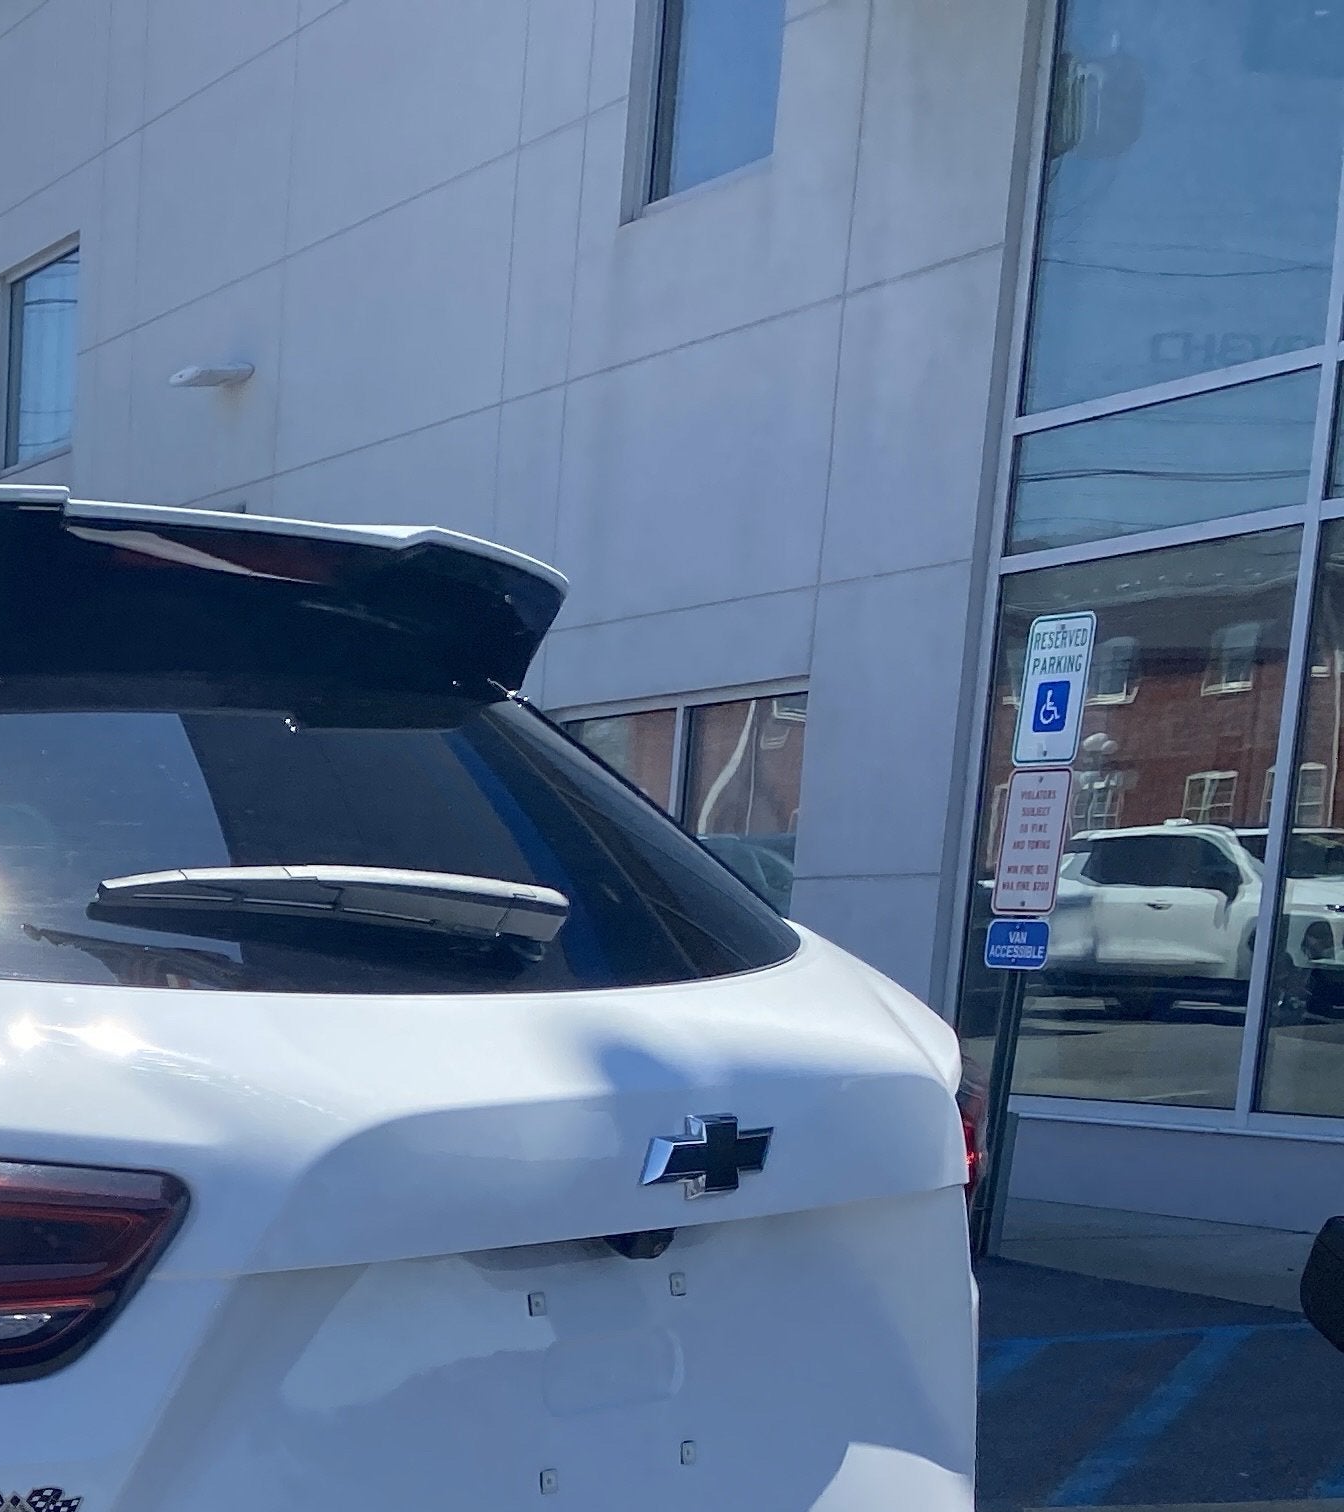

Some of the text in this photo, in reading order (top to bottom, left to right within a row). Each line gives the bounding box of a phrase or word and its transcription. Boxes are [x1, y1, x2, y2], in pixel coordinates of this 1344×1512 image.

[1034, 628, 1088, 650] RESERVED
[1032, 655, 1083, 675] PARKING
[1008, 931, 1028, 944] VAN
[989, 944, 1045, 959] ACCESSIBLE
